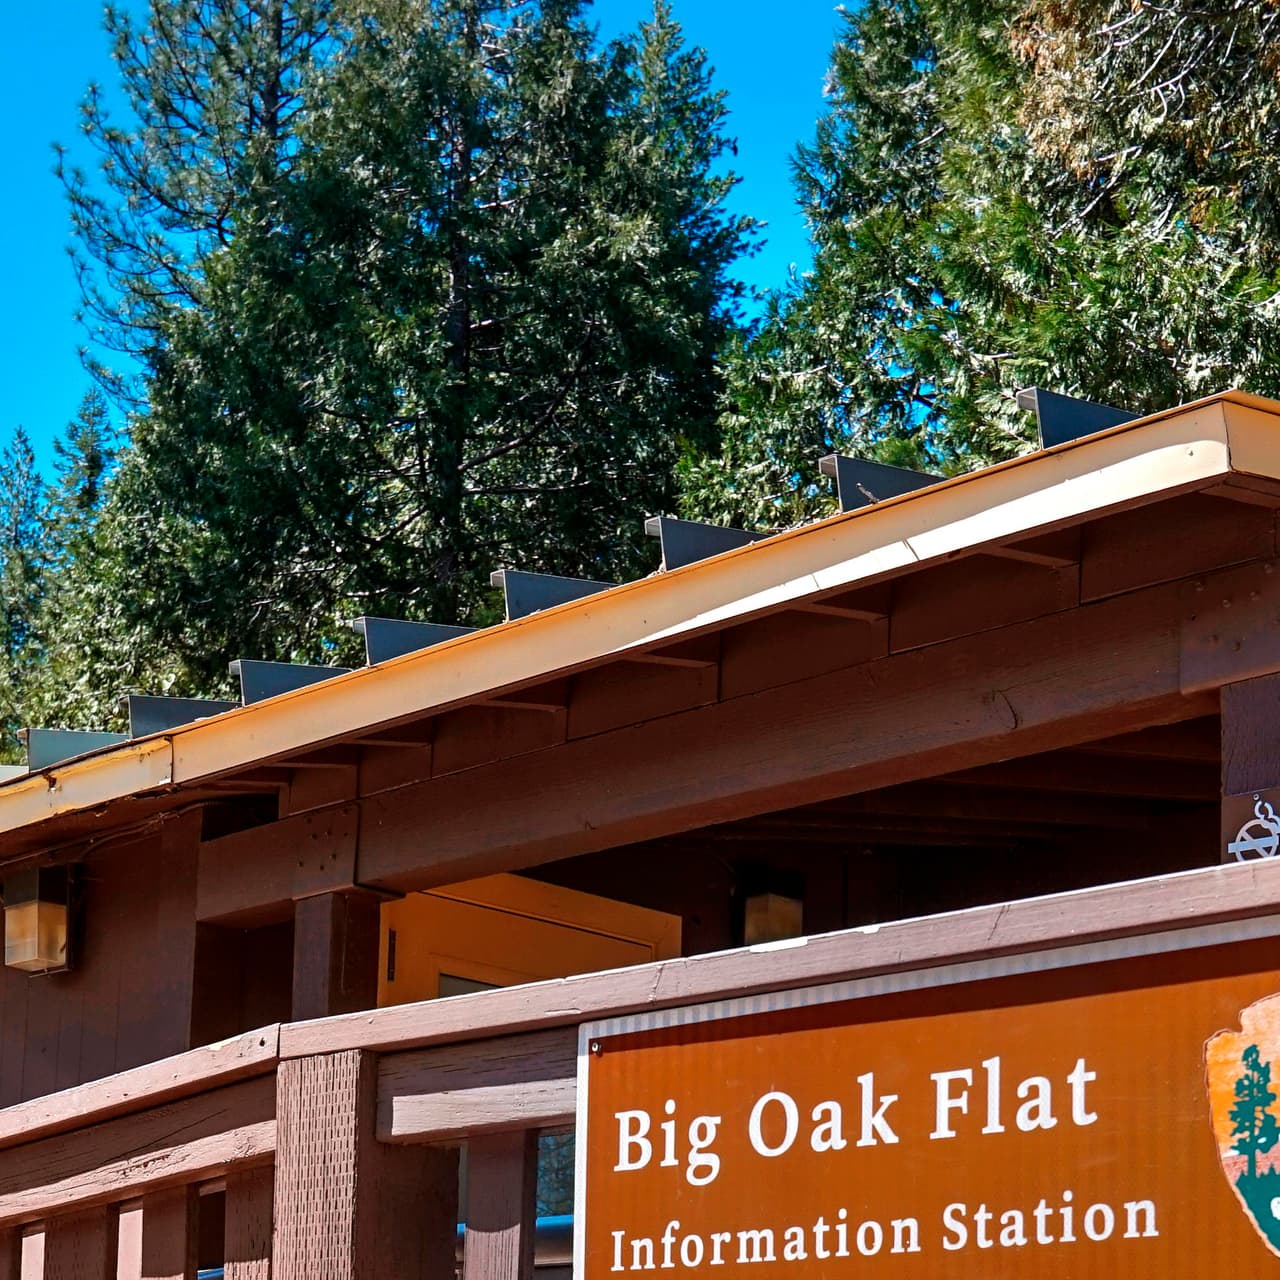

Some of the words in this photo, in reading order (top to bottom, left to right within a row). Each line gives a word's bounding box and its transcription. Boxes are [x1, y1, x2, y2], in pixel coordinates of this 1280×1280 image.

[613, 1099, 722, 1186] Big
[748, 1071, 900, 1157] Oak
[929, 1055, 1099, 1140] Flat
[610, 1208, 922, 1273] Information
[942, 1190, 1160, 1251] Station
